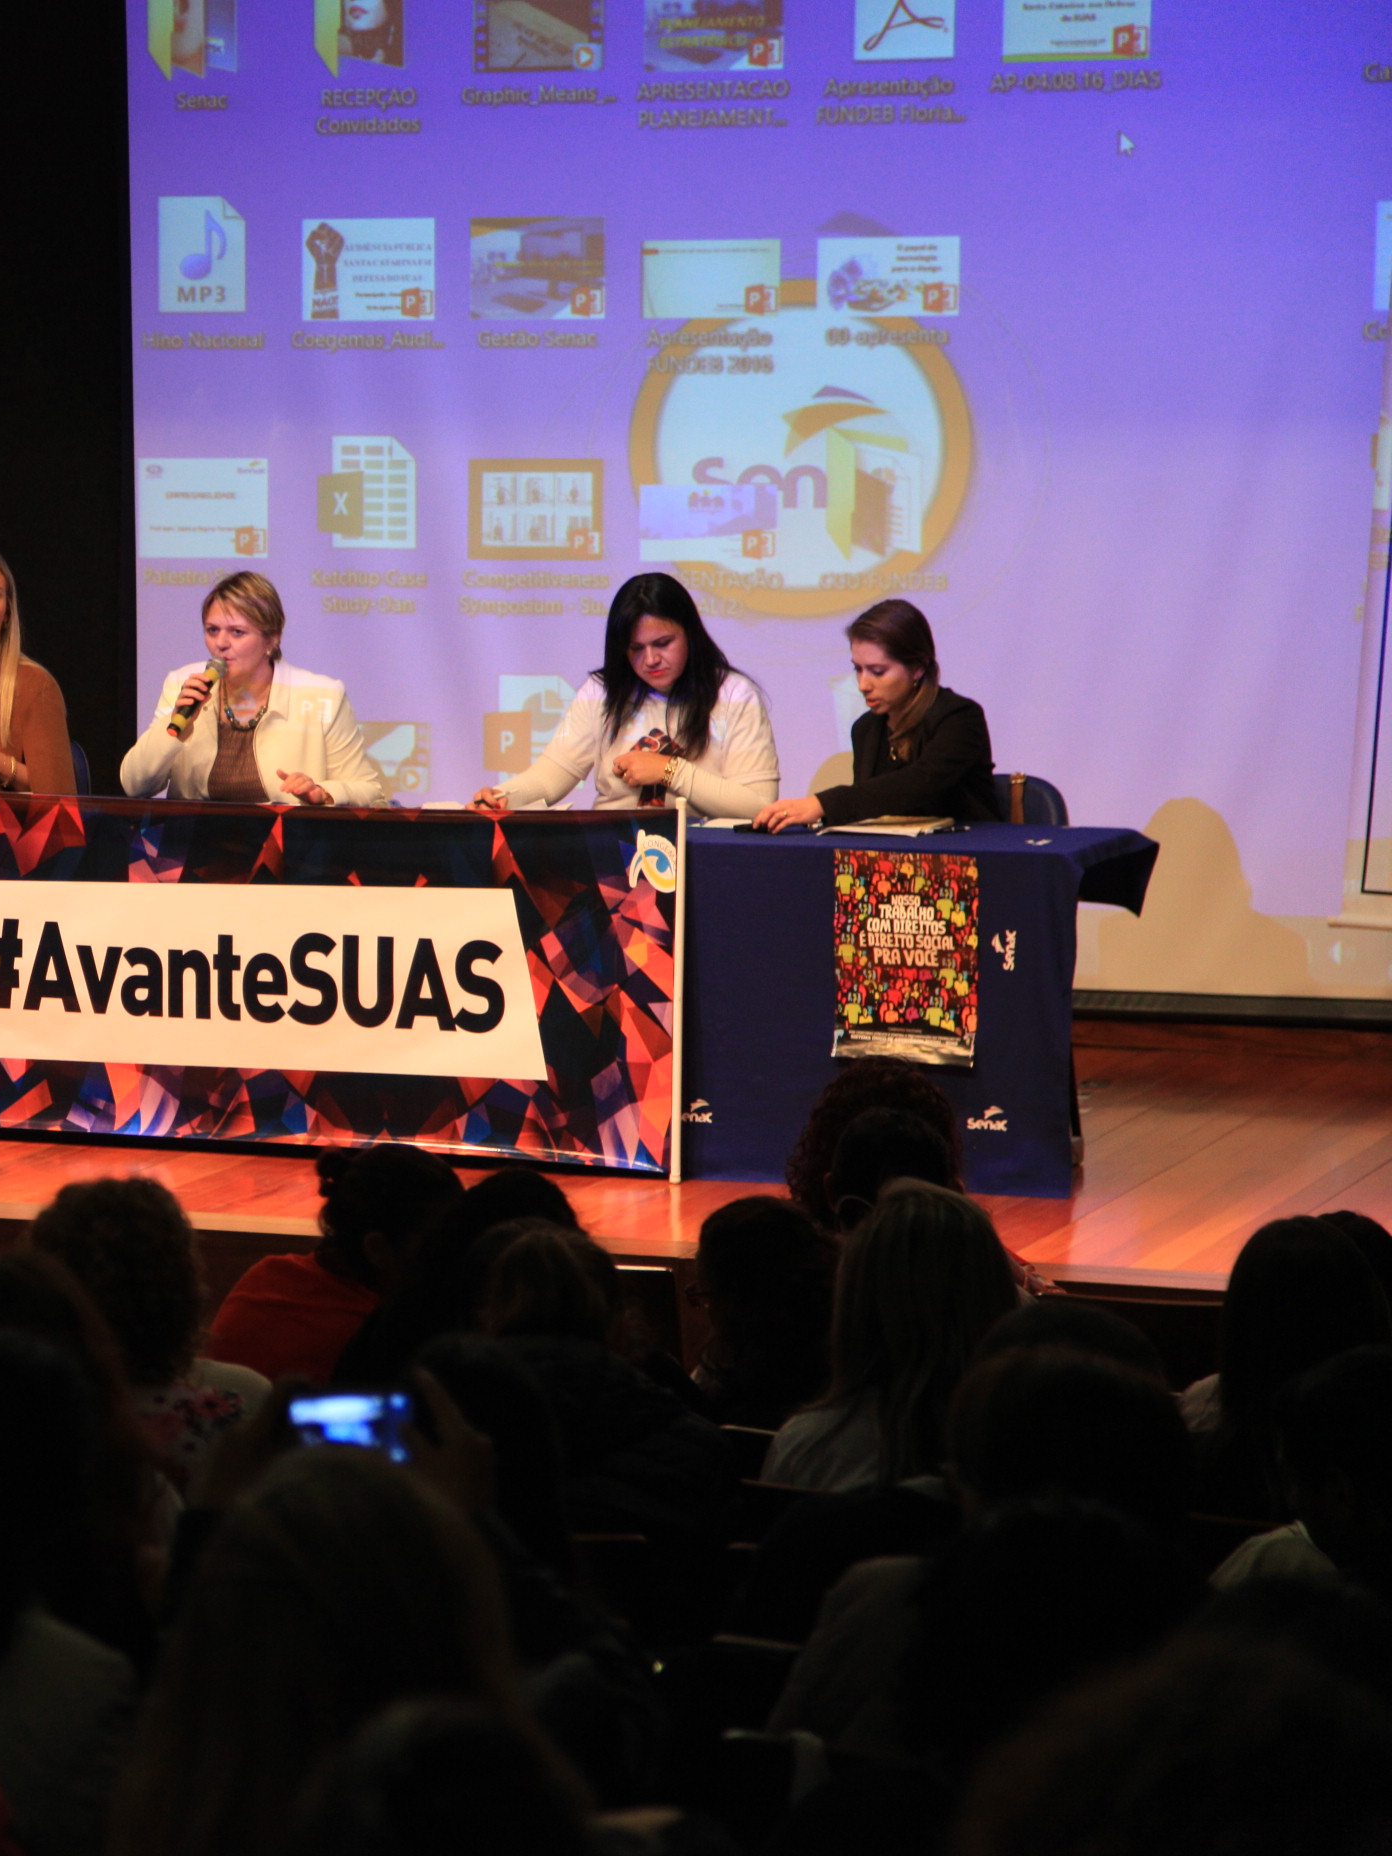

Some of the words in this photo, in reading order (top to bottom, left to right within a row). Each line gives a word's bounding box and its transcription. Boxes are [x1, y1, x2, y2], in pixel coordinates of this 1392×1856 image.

[824, 76, 954, 99] Apresentação
[176, 92, 227, 108] Senac
[815, 104, 894, 123] FUNDEB
[316, 116, 420, 133] Convidados
[176, 285, 227, 303] MP3
[142, 332, 183, 348] Hino
[188, 331, 264, 348] Nacional
[478, 330, 539, 347] Gestão
[544, 329, 597, 347] Senac
[311, 569, 382, 589] Ketchup
[384, 570, 427, 588] Case
[462, 570, 610, 590] Competitiveness
[458, 597, 563, 617] Symposium
[891, 894, 921, 907] NOSSO
[878, 903, 935, 921] TRABALHO
[866, 917, 891, 932] COM
[893, 918, 946, 936] DIREITOS
[859, 930, 867, 947] É
[868, 932, 914, 949] DIREITO
[915, 934, 955, 951] SOCIAL
[873, 947, 901, 966] PRA
[903, 948, 940, 967] VOCÊ
[681, 1110, 713, 1124] enac
